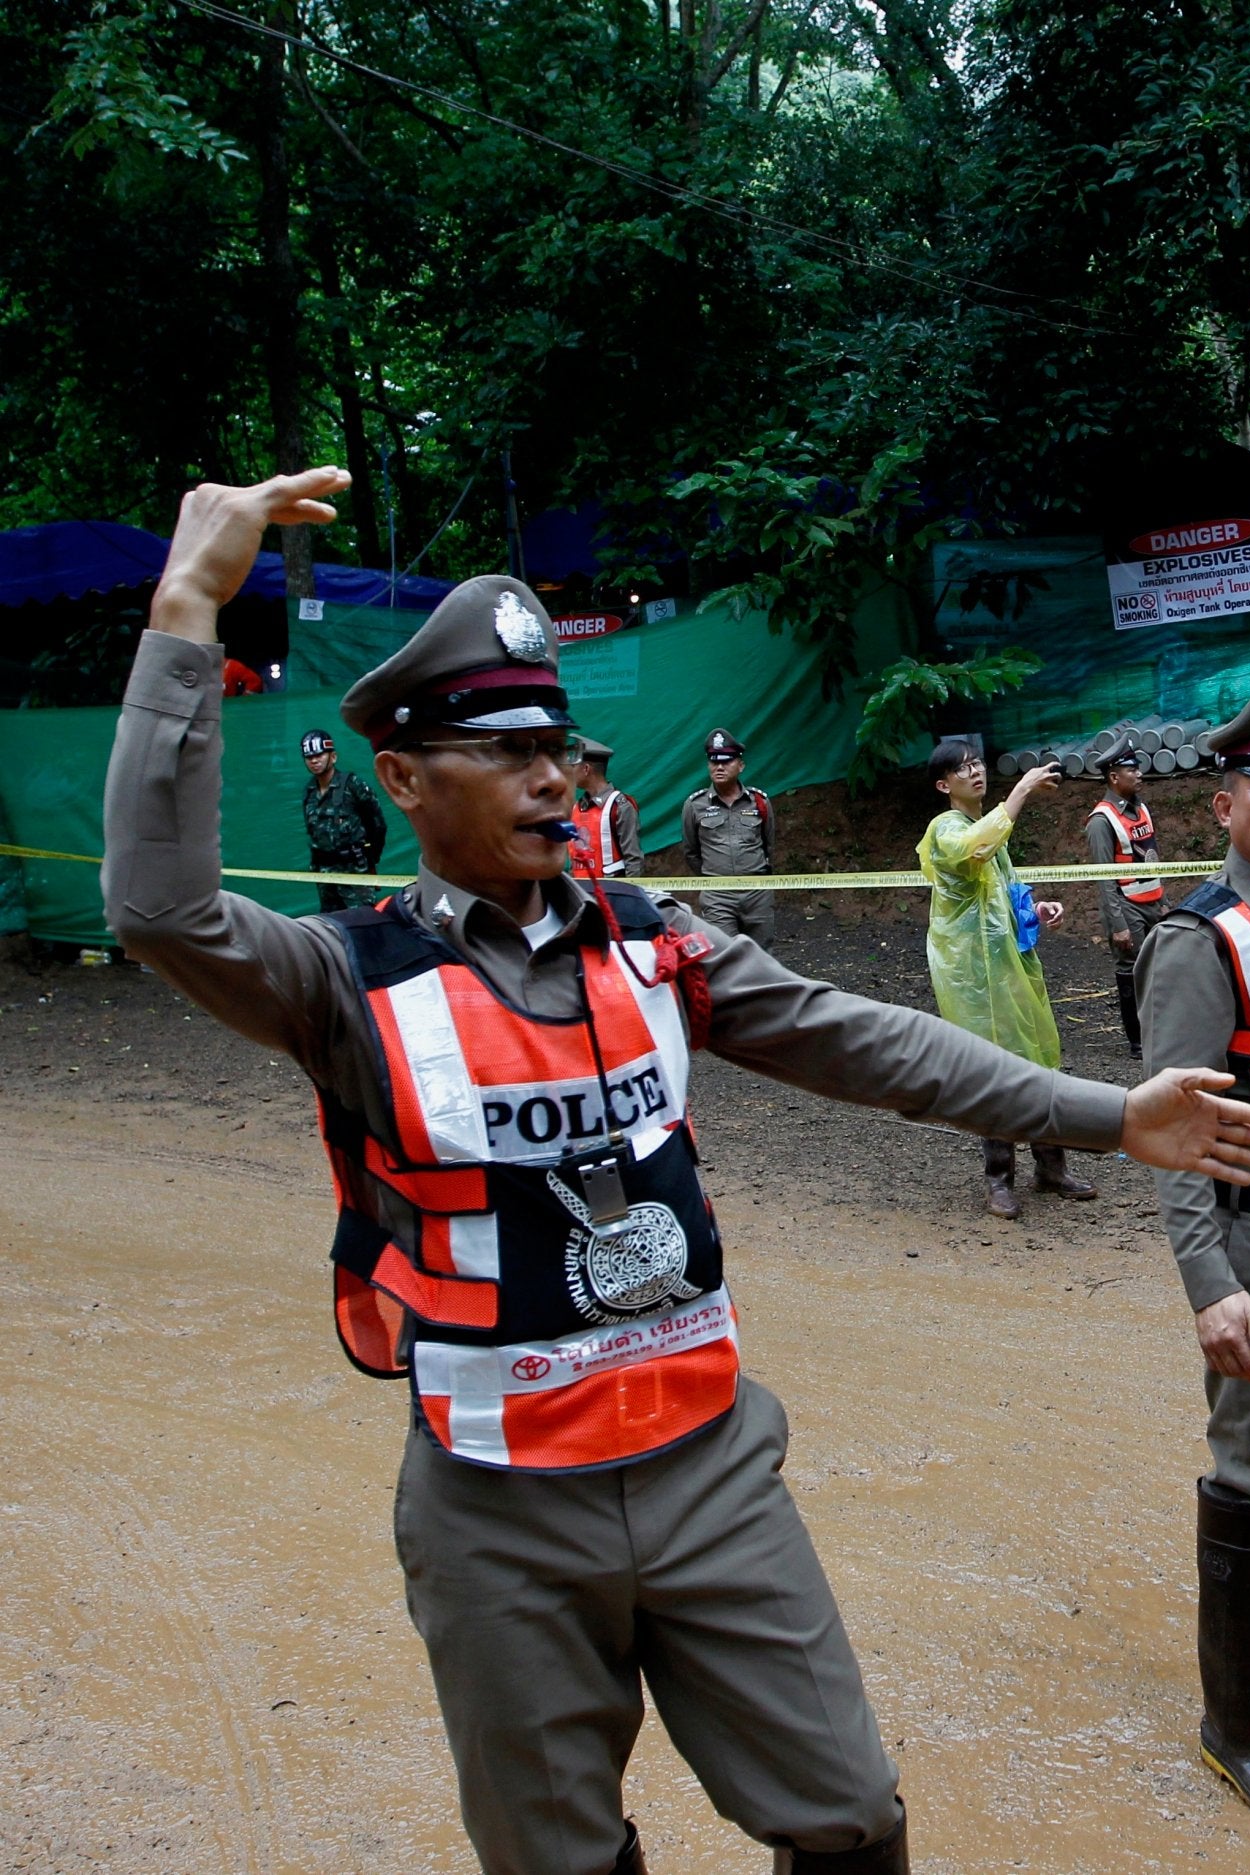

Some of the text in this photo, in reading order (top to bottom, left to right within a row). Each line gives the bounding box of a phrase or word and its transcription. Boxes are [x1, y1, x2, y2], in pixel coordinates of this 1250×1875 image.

[1151, 523, 1239, 551] DANGER
[1118, 597, 1138, 610] NO
[1167, 607, 1196, 618] Oxigen
[1200, 602, 1221, 612] Tank
[1120, 609, 1158, 623] SMOKING
[553, 617, 606, 636] ANGER
[650, 1305, 725, 1338] เชียงรา
